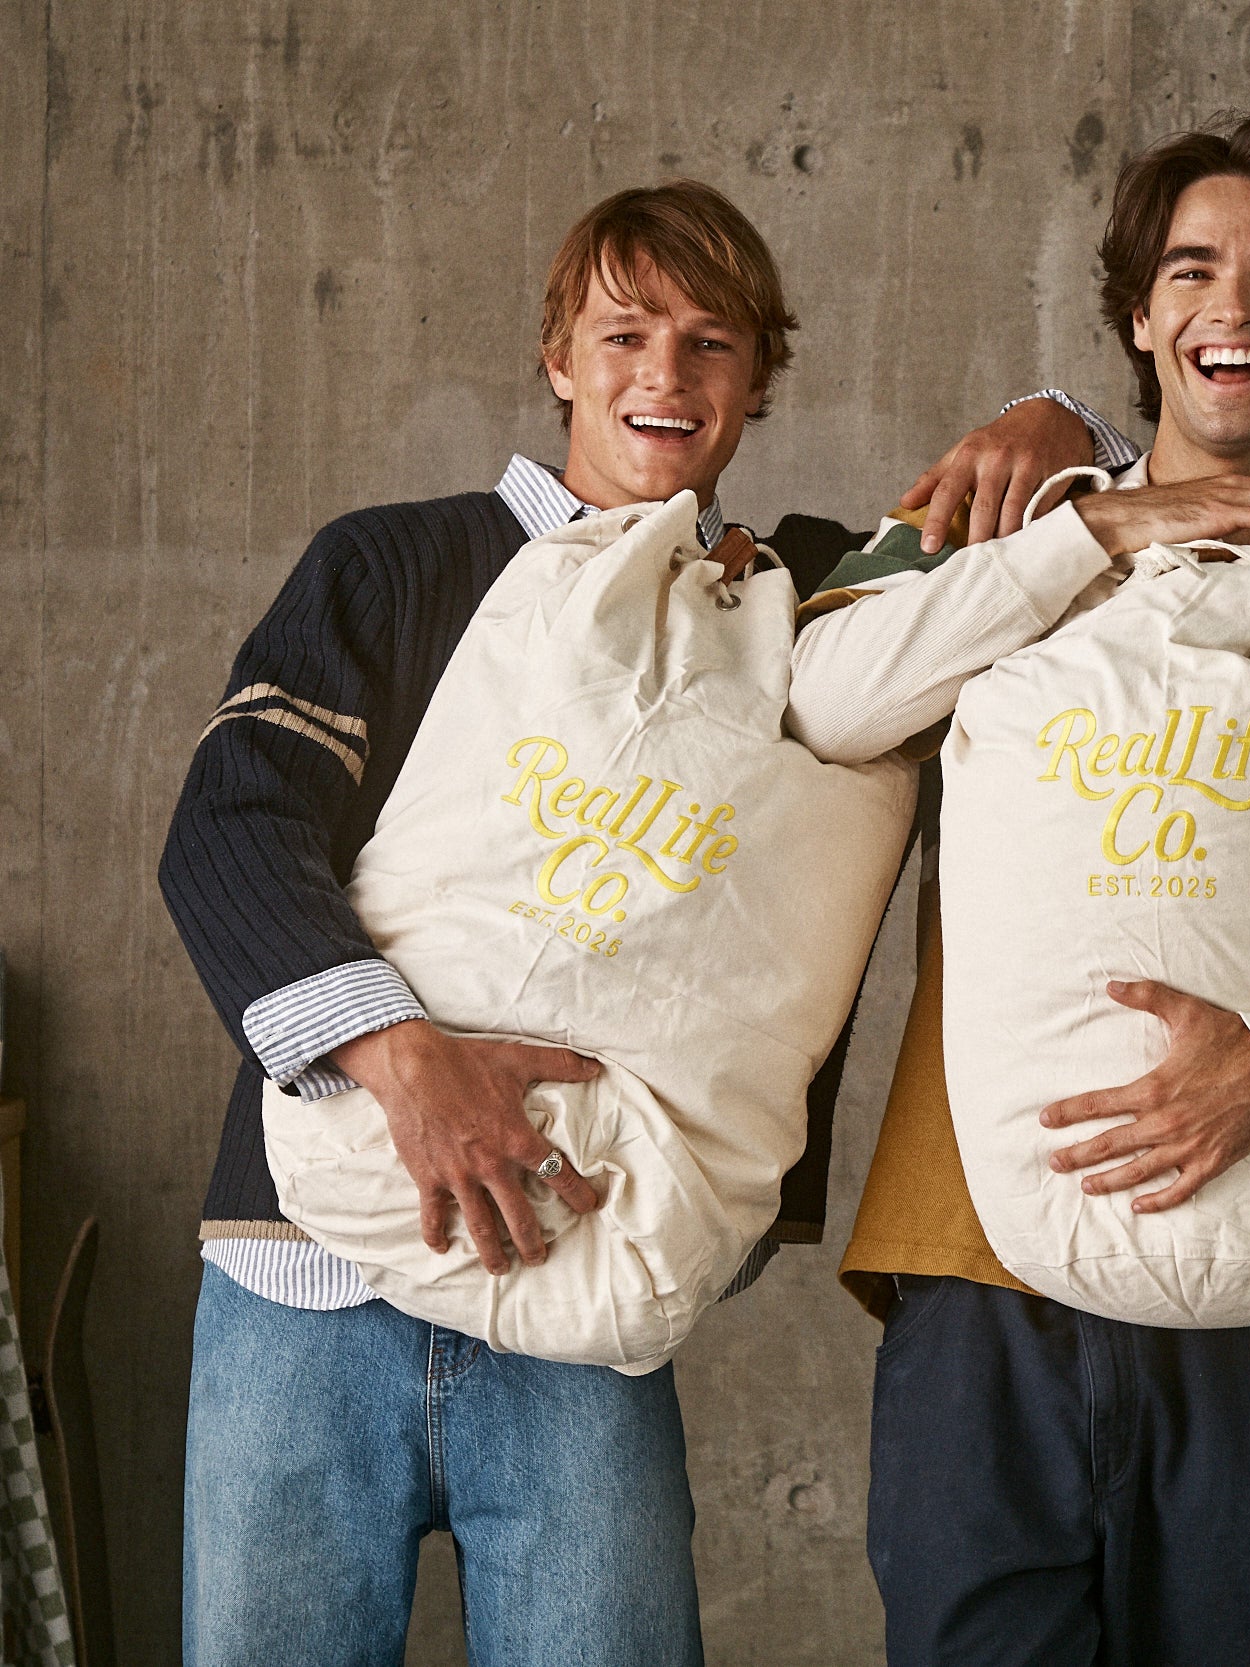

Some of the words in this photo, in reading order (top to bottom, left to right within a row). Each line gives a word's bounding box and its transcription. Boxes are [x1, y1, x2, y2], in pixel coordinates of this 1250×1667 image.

[1101, 782, 1208, 866] Co.
[537, 834, 629, 923] Co.
[1087, 874, 1142, 897] EST.
[1150, 875, 1217, 899] 2025
[508, 900, 556, 928] EST.
[557, 916, 623, 958] 2025
